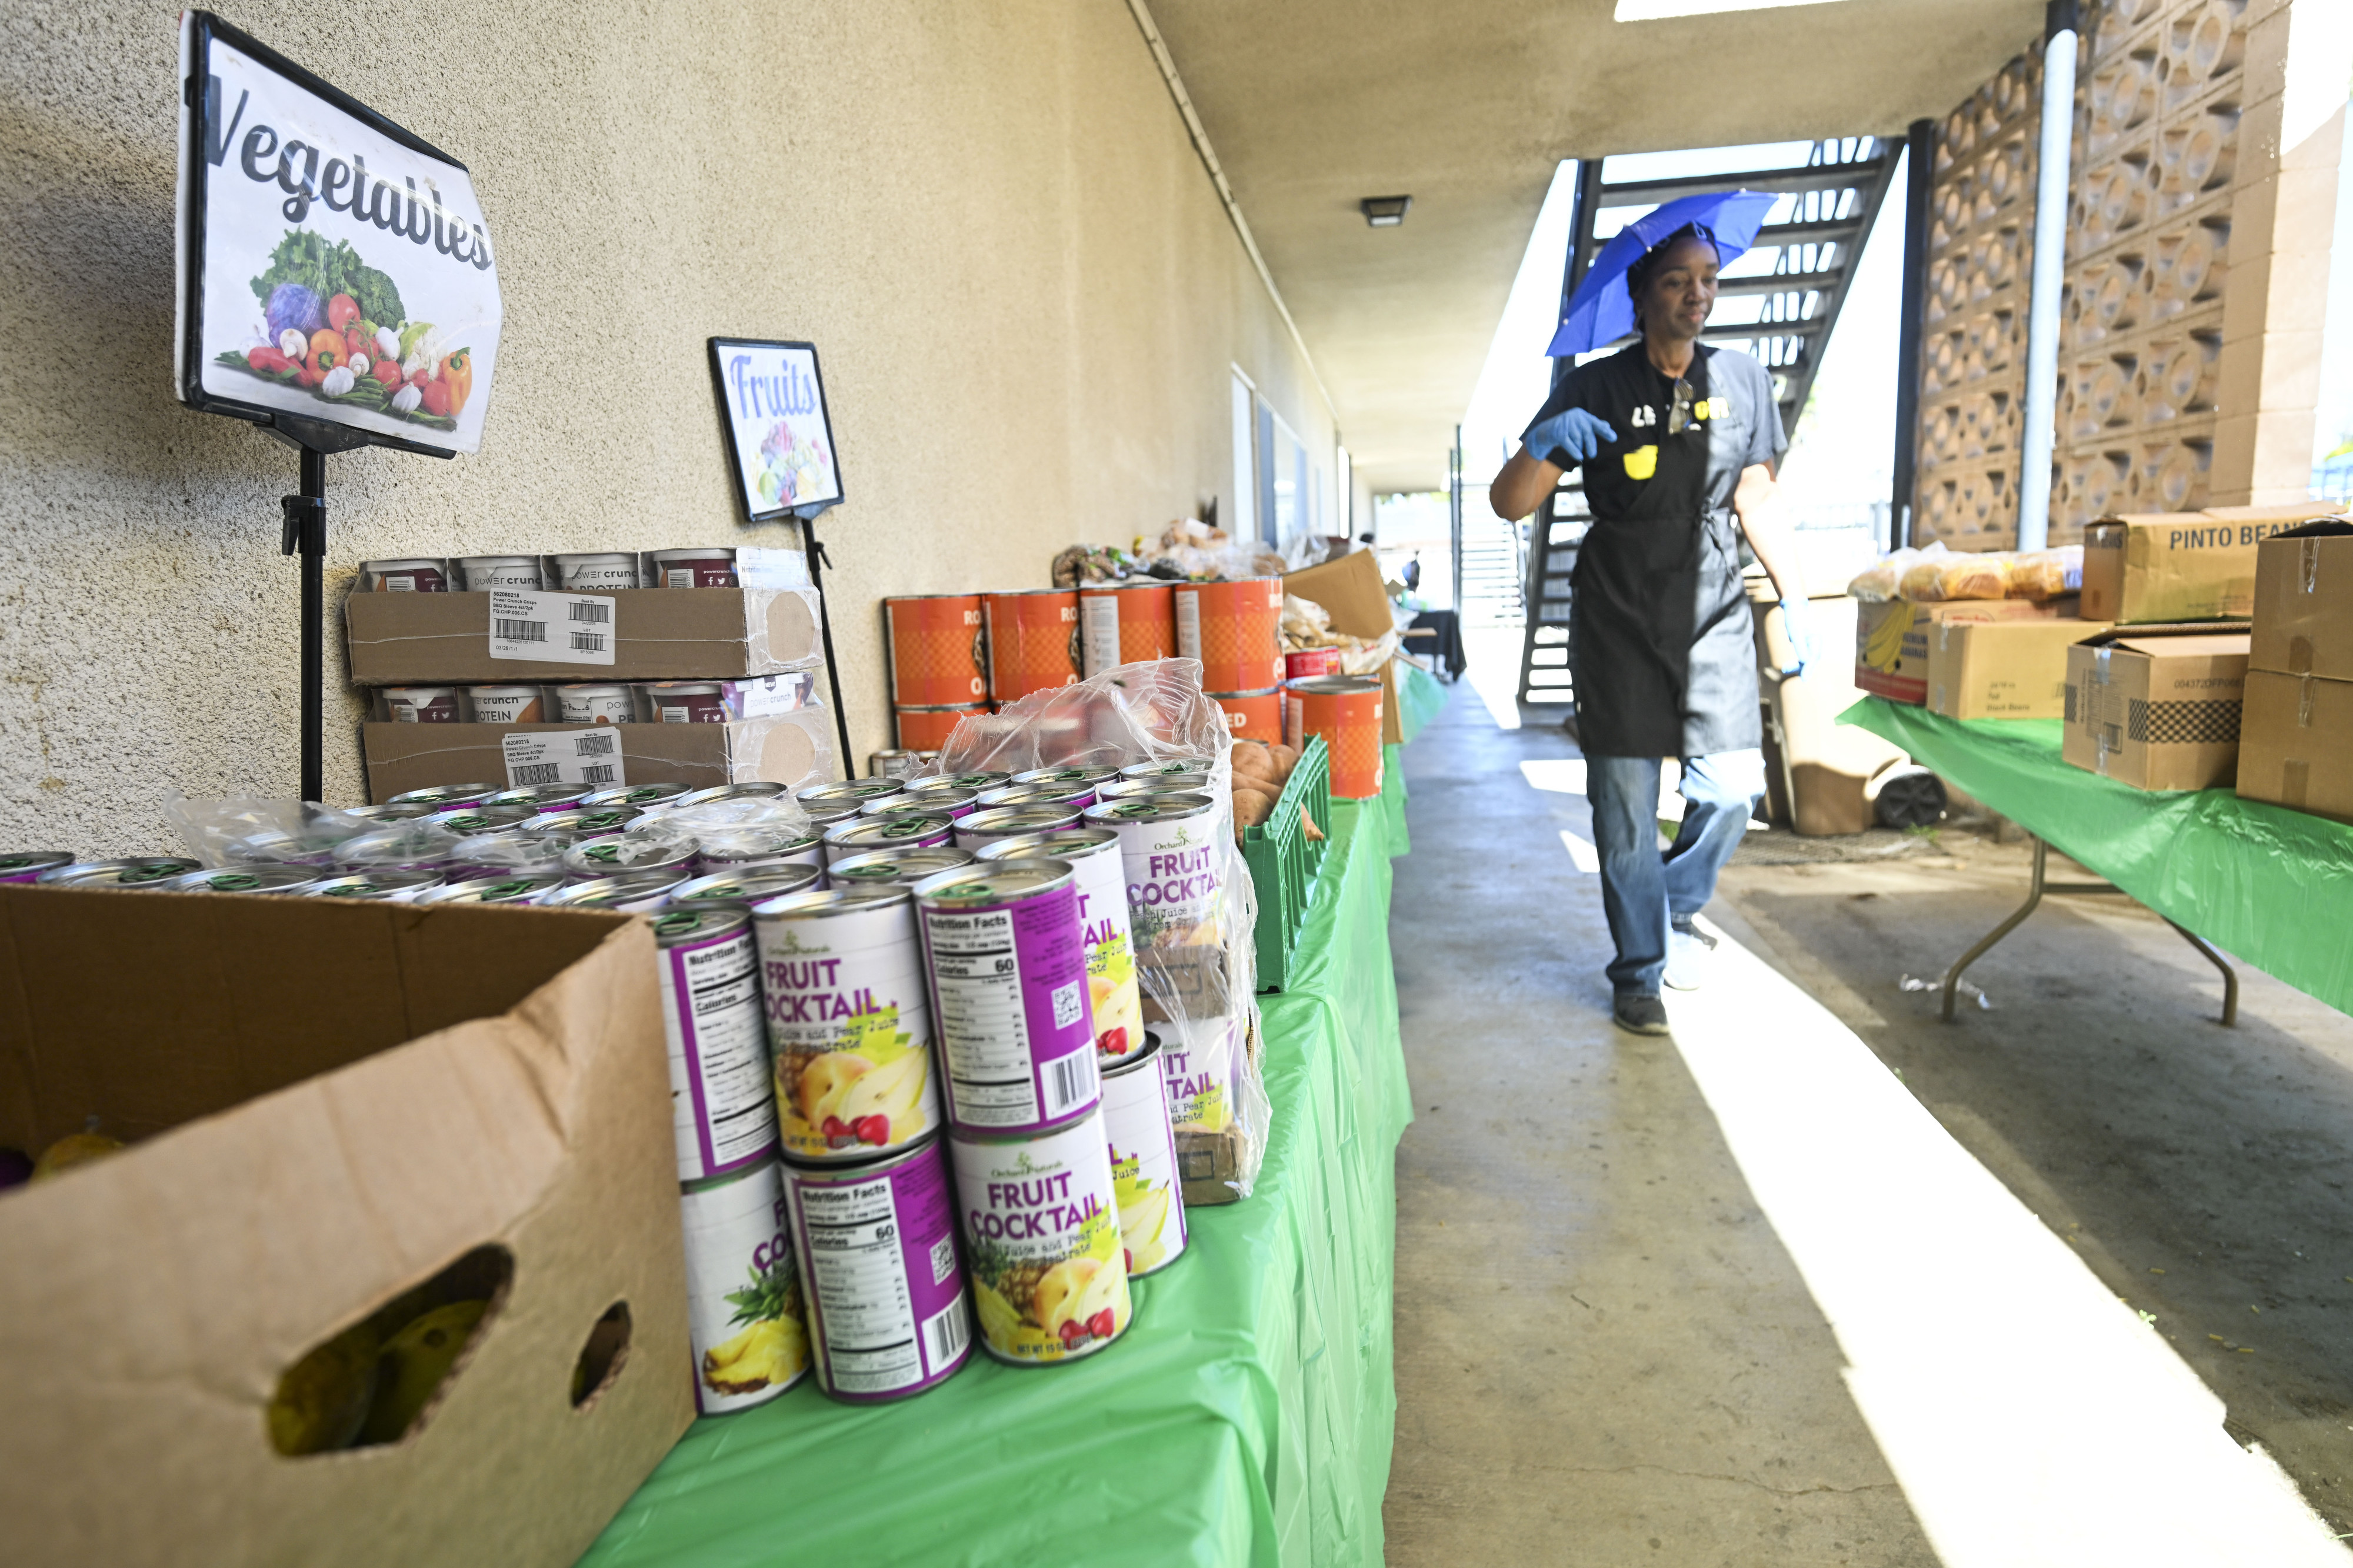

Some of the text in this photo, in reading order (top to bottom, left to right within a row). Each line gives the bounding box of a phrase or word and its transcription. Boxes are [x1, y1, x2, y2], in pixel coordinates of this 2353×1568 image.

[184, 74, 492, 271] Vegetables
[730, 355, 816, 419] Fruits
[2171, 526, 2232, 551] PINTO
[770, 692, 791, 703] crunch
[607, 700, 634, 711] powe
[476, 710, 512, 721] ROTEIN
[1154, 840, 1182, 850] Orchard
[1149, 845, 1211, 879] FRUIT
[1161, 908, 1188, 918] Juice
[974, 916, 1007, 928] Facts
[1148, 922, 1171, 930] from
[689, 946, 736, 965] Nutrition
[1085, 950, 1107, 963] Pear
[995, 958, 1014, 972] 60
[766, 958, 841, 990] FRUIT
[696, 995, 736, 1012] Calories
[766, 987, 881, 1023] OCKTAIL
[833, 1025, 862, 1038] Pear
[1184, 1101, 1204, 1112] Pear
[1112, 1167, 1139, 1180] Juice
[853, 1185, 886, 1199] Facts
[988, 1170, 1072, 1209] FRUIT
[971, 1192, 1102, 1240] COCKTAIL
[876, 1225, 894, 1239] 60
[1041, 1239, 1062, 1253] and
[1068, 1229, 1092, 1246] Pear
